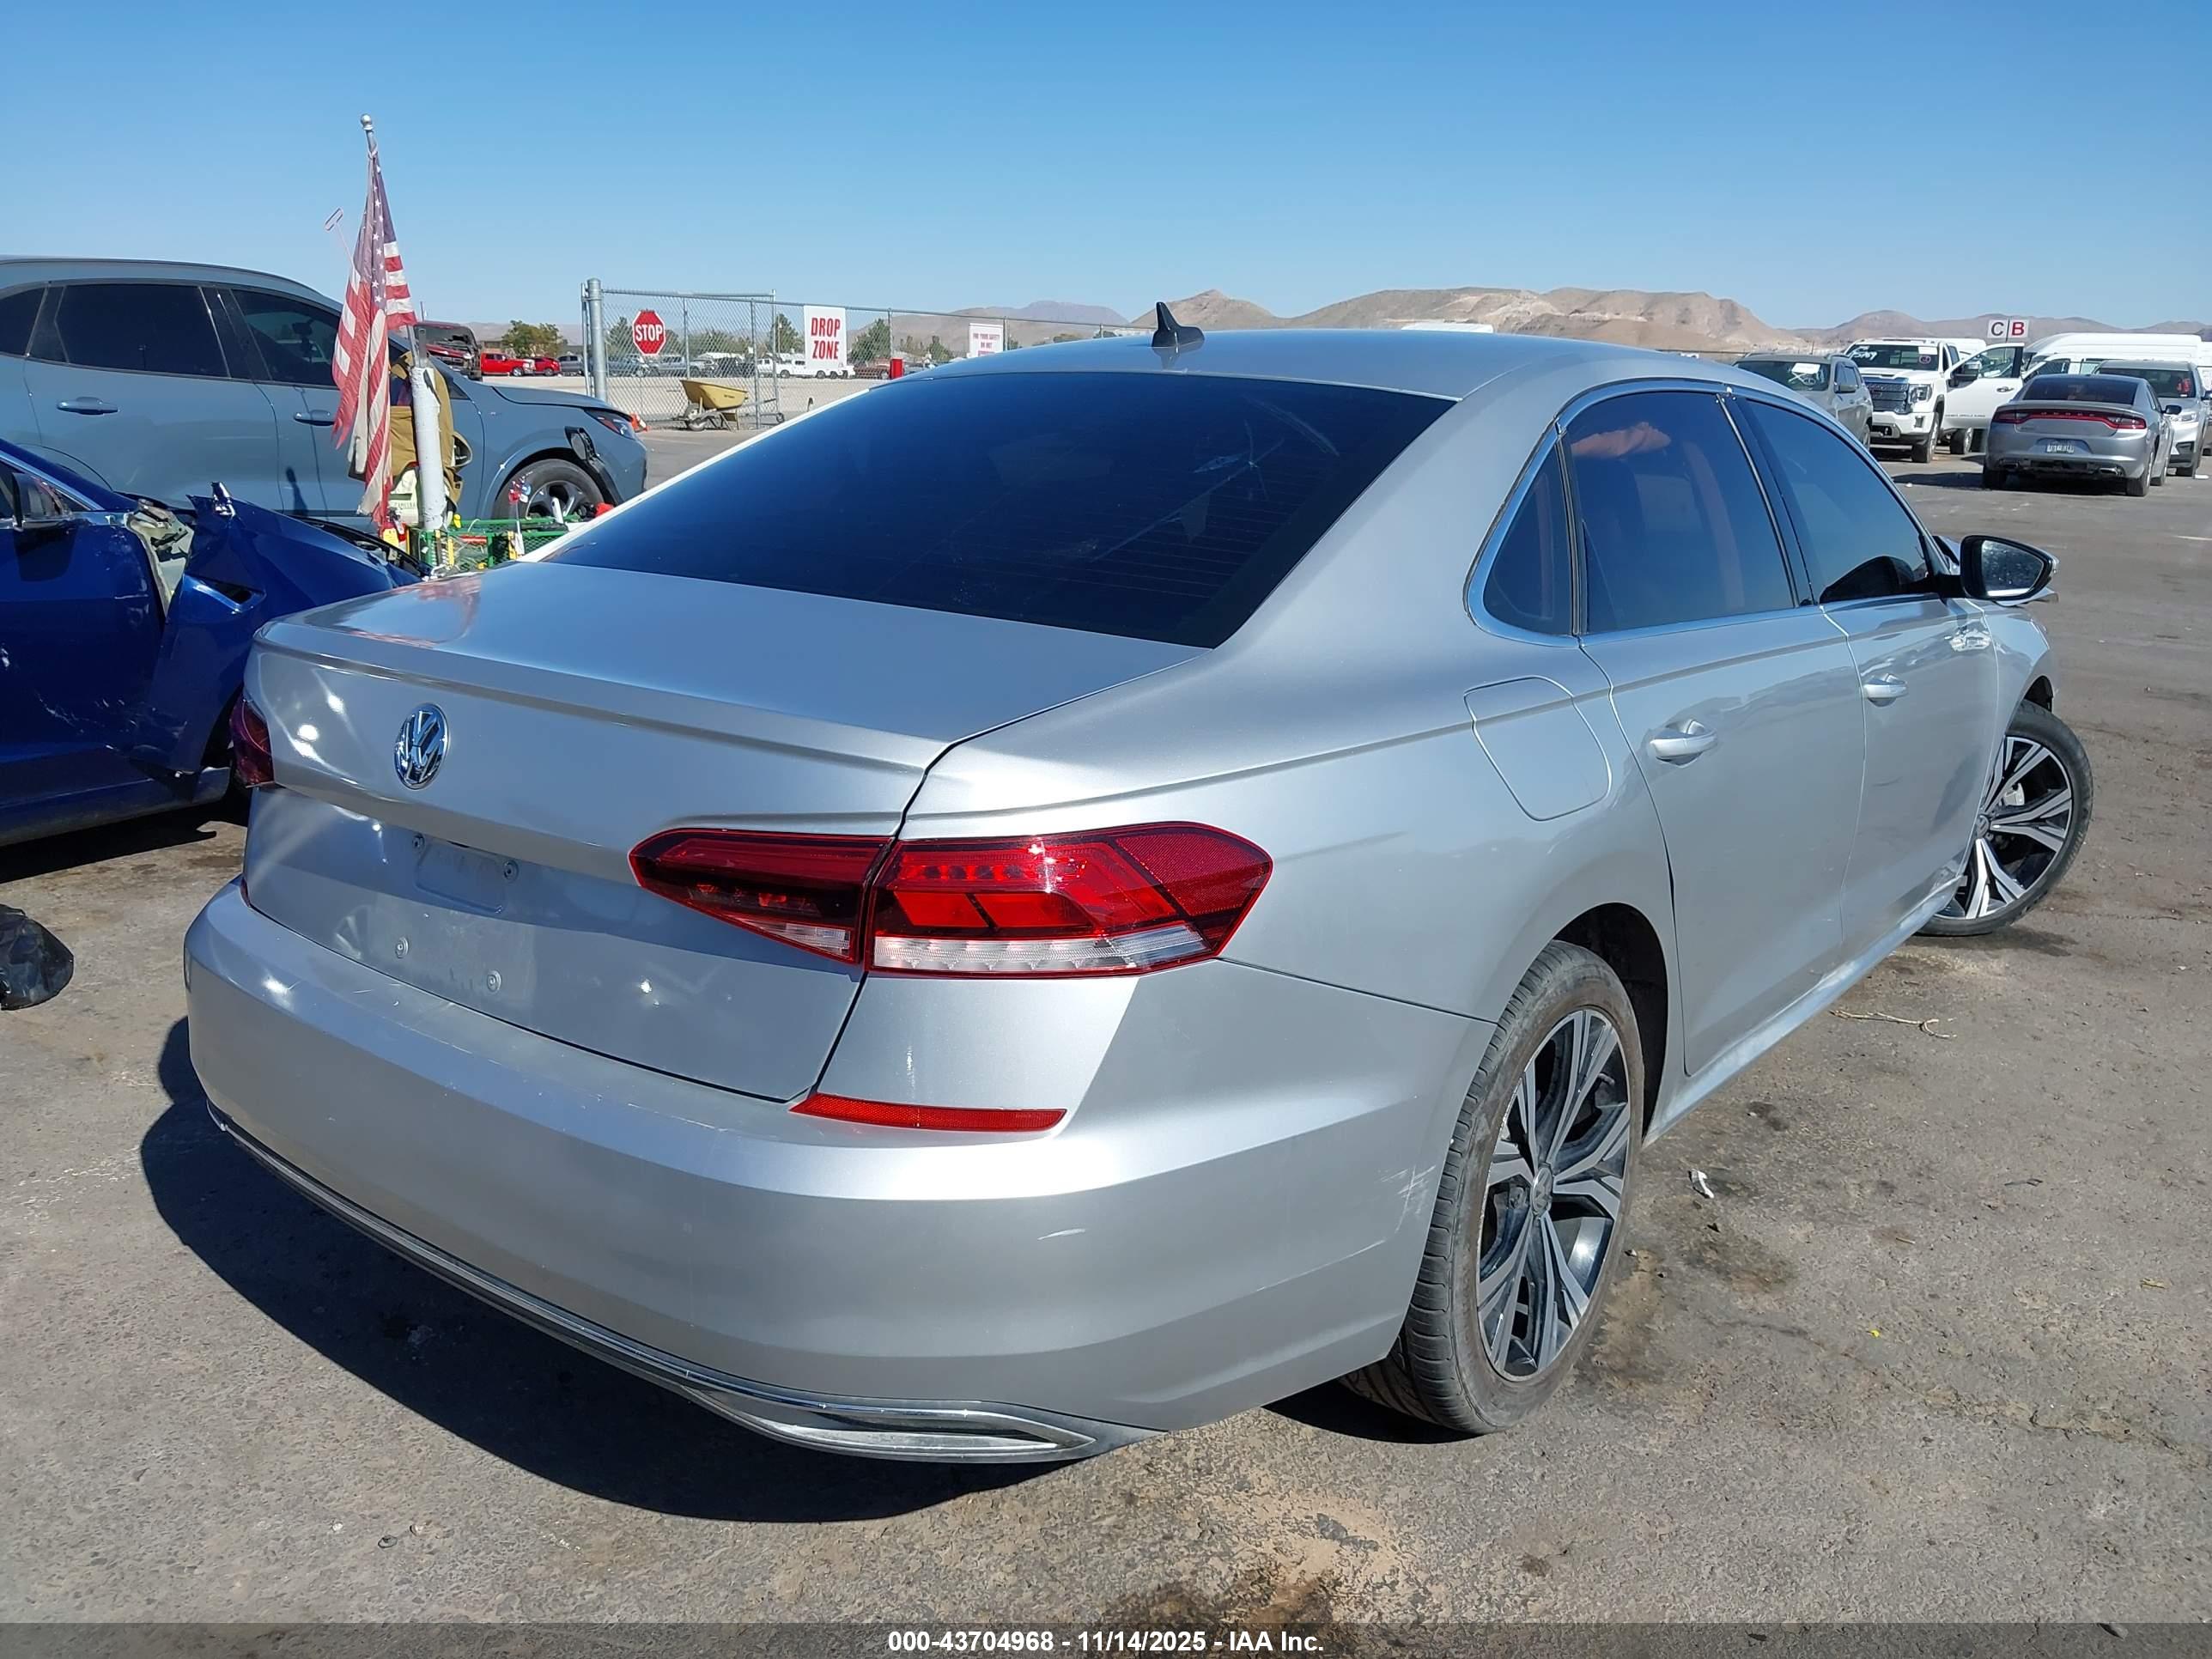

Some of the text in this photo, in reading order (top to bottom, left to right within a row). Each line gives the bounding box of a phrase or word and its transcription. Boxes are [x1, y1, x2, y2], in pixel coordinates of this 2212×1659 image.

[635, 324, 663, 342] STOP
[811, 318, 841, 337] DROP
[1990, 321, 2004, 336] C
[2011, 321, 2025, 336] B
[812, 341, 839, 360] ZONE
